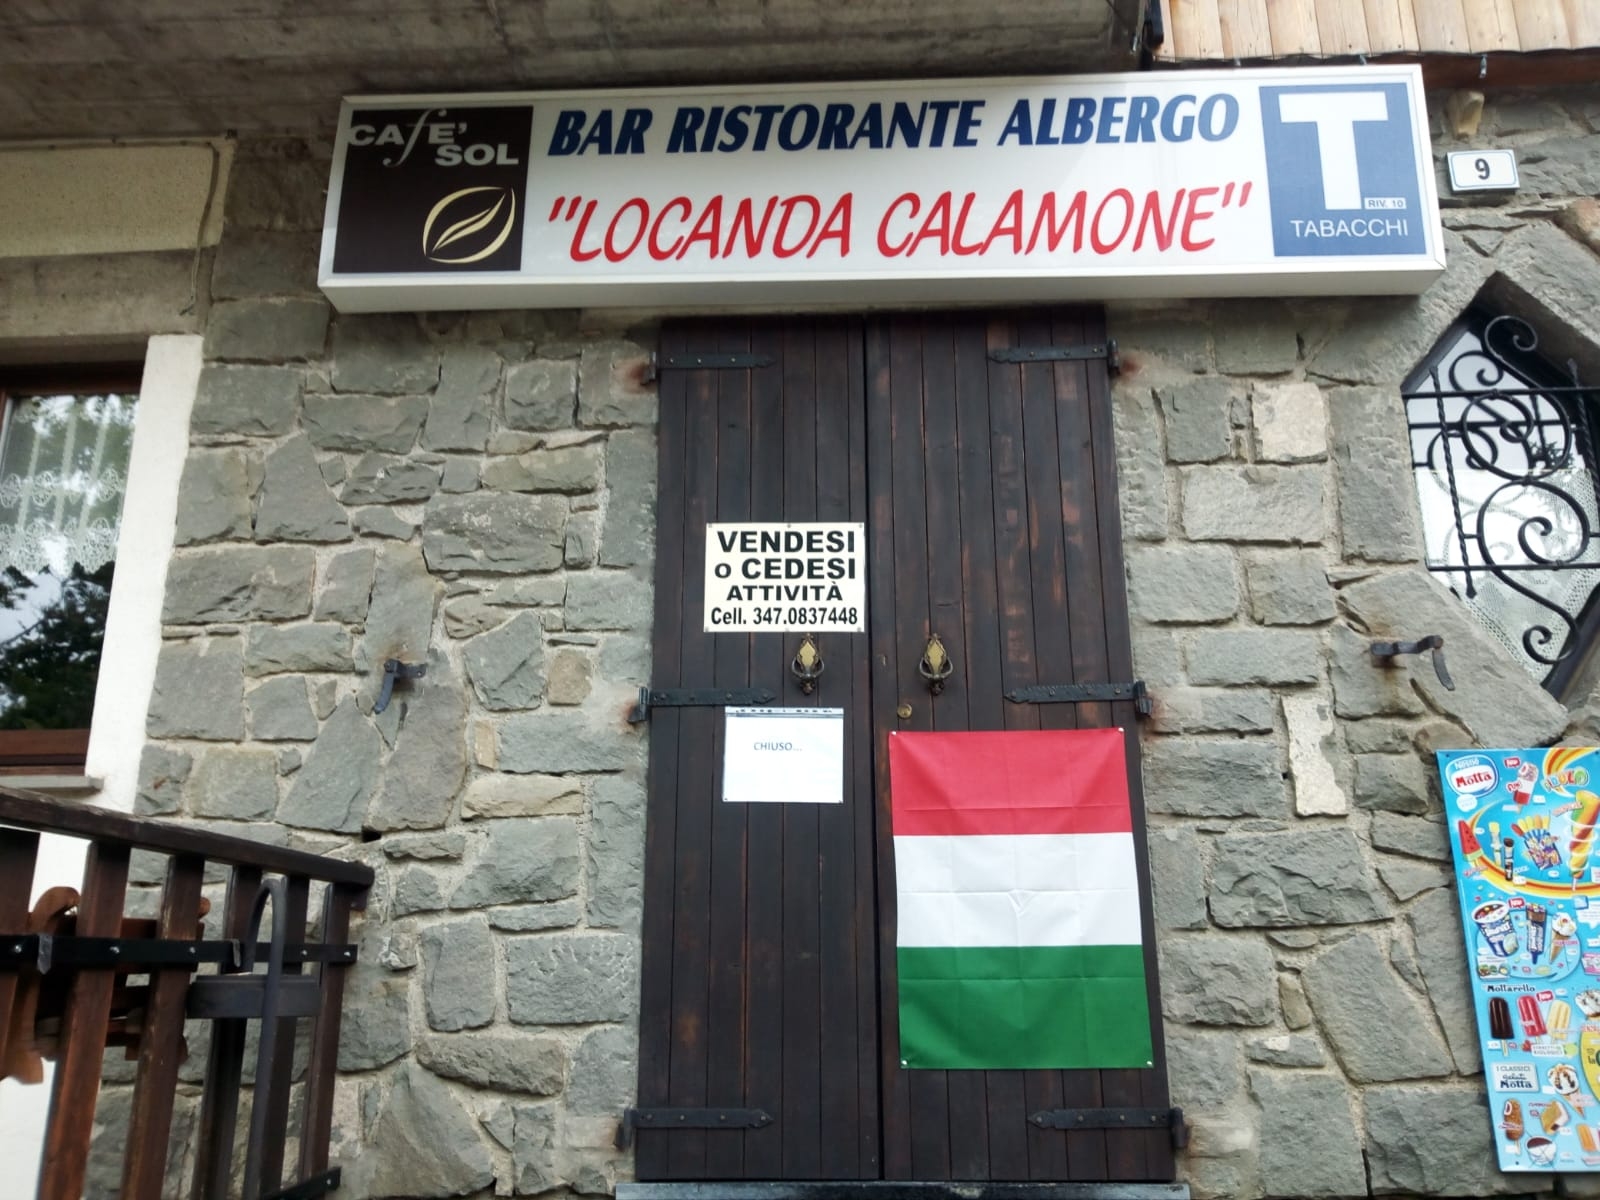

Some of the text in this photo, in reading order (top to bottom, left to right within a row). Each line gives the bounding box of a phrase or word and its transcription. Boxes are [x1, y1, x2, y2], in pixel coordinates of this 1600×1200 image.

[548, 93, 1239, 156] BAR RISTORANTE ALBERGO
[434, 143, 519, 167] SOL
[1278, 91, 1389, 210] T
[1474, 158, 1491, 180] 9
[1367, 199, 1404, 209] RIV. 10
[1290, 218, 1409, 238] TABACCHI
[716, 531, 855, 553] VENDESI
[741, 558, 856, 579] CEDESI
[726, 581, 843, 601] ATTIVITÀ
[711, 607, 858, 625] Cell. 347.0837448
[1455, 772, 1492, 788] Motta
